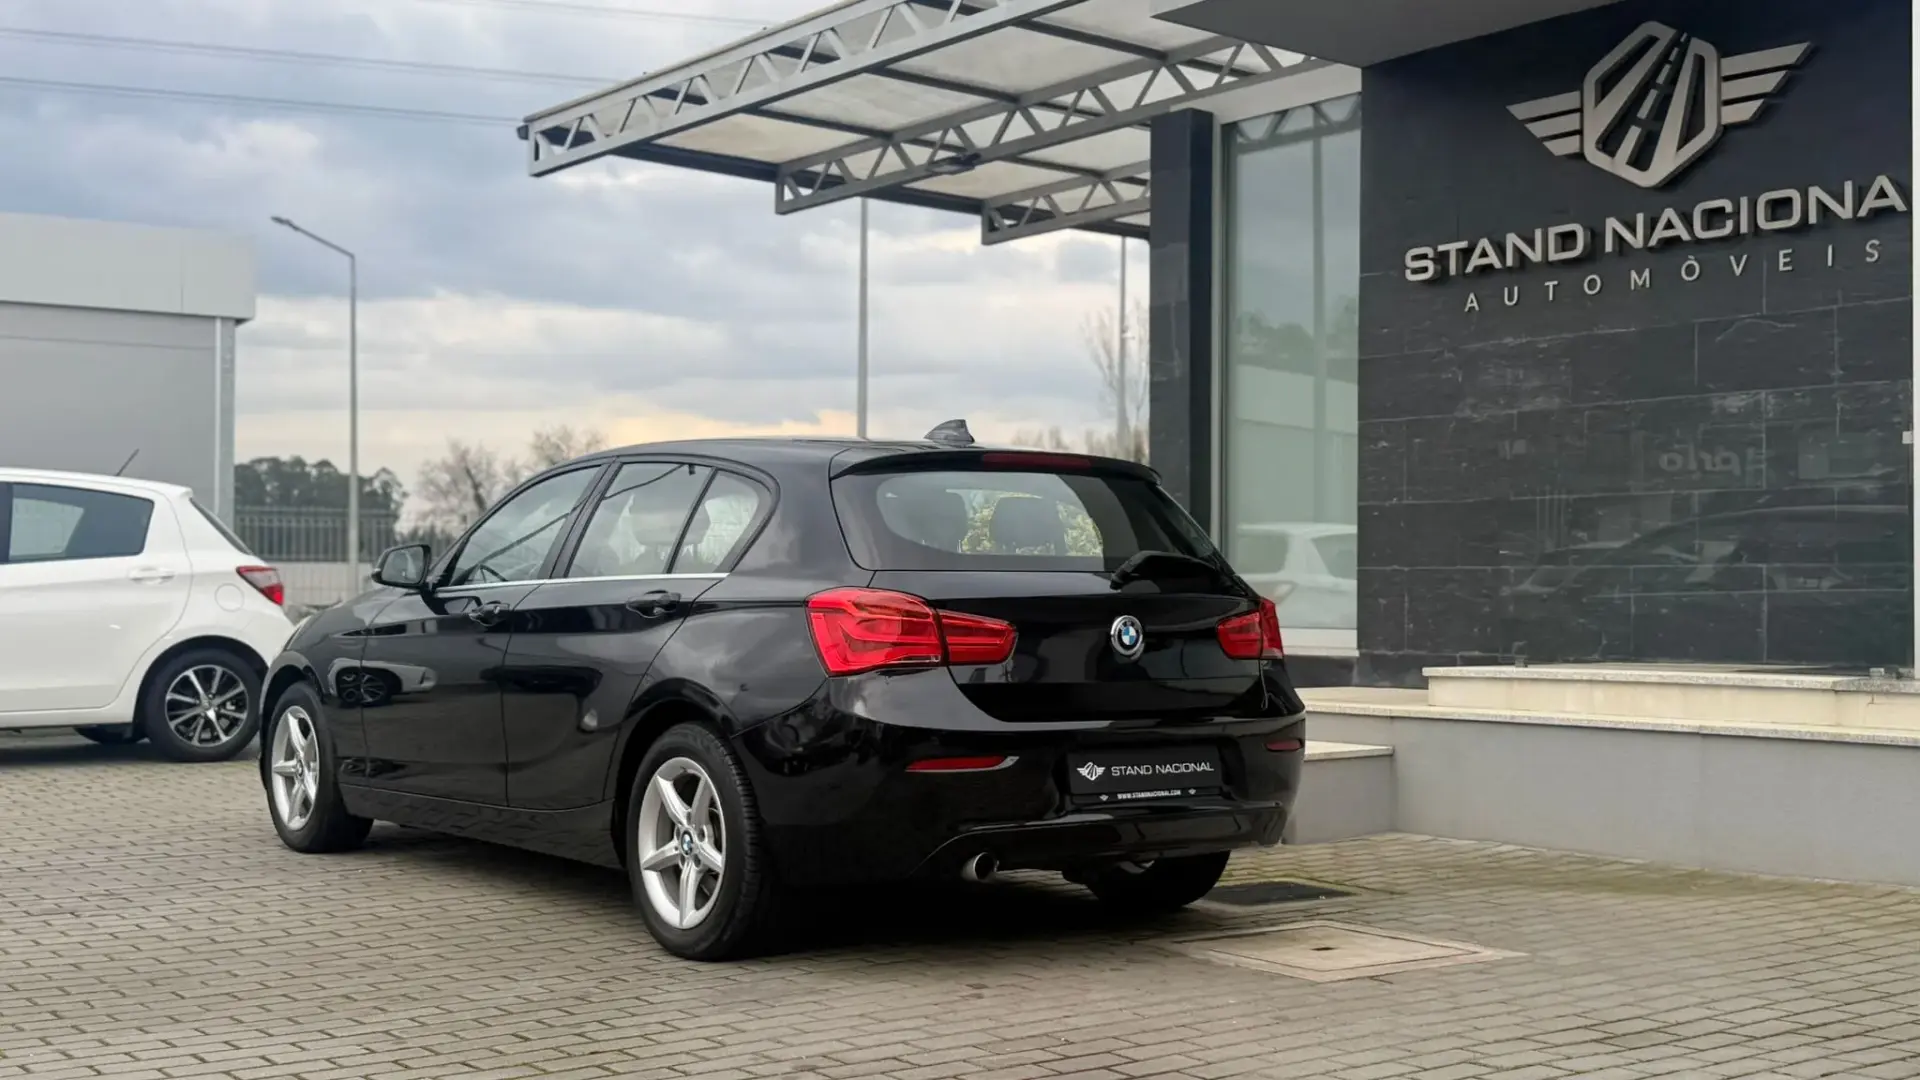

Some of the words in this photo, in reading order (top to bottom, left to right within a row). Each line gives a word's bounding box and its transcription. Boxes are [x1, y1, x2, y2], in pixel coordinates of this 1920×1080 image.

[1405, 222, 1586, 282] STAND
[1111, 764, 1152, 777] STAND
[1155, 762, 1215, 774] NACIONAL
